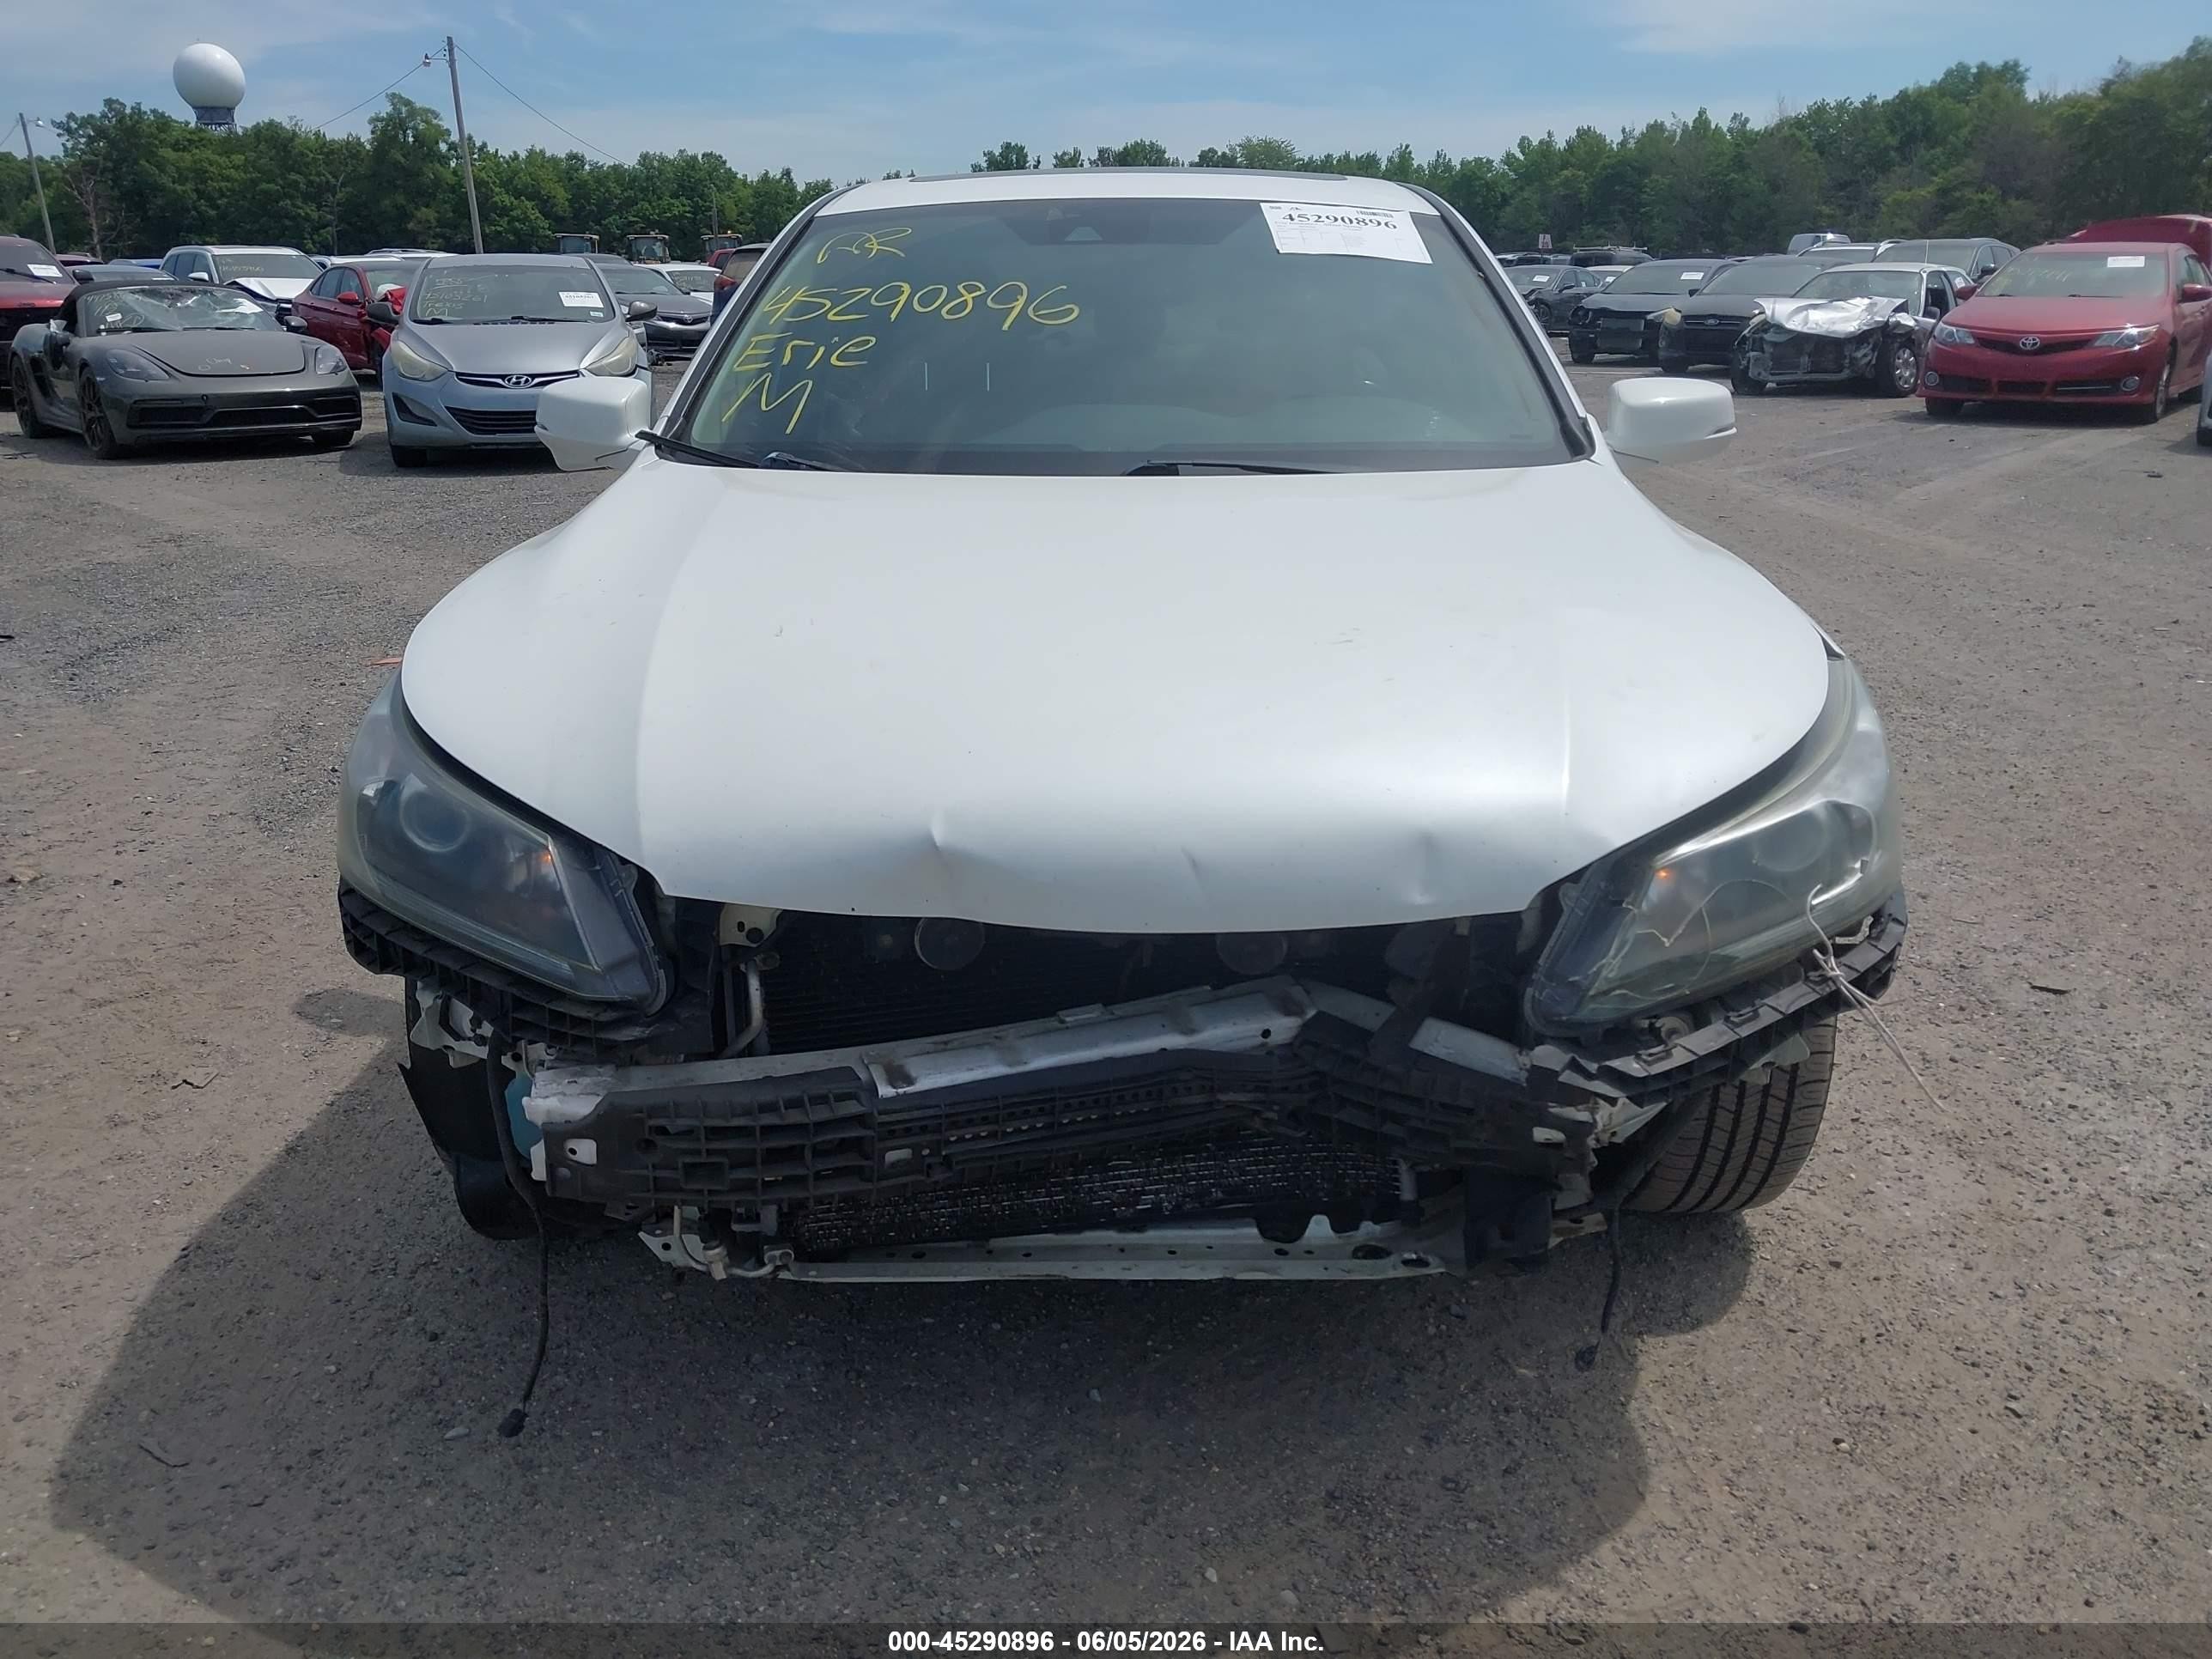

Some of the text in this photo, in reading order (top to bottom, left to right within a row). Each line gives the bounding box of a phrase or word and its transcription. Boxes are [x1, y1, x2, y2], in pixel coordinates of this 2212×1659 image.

[1282, 213, 1397, 230] 45290896
[763, 281, 1080, 331] 45290896
[733, 331, 877, 371] Erie
[721, 372, 814, 435] M
